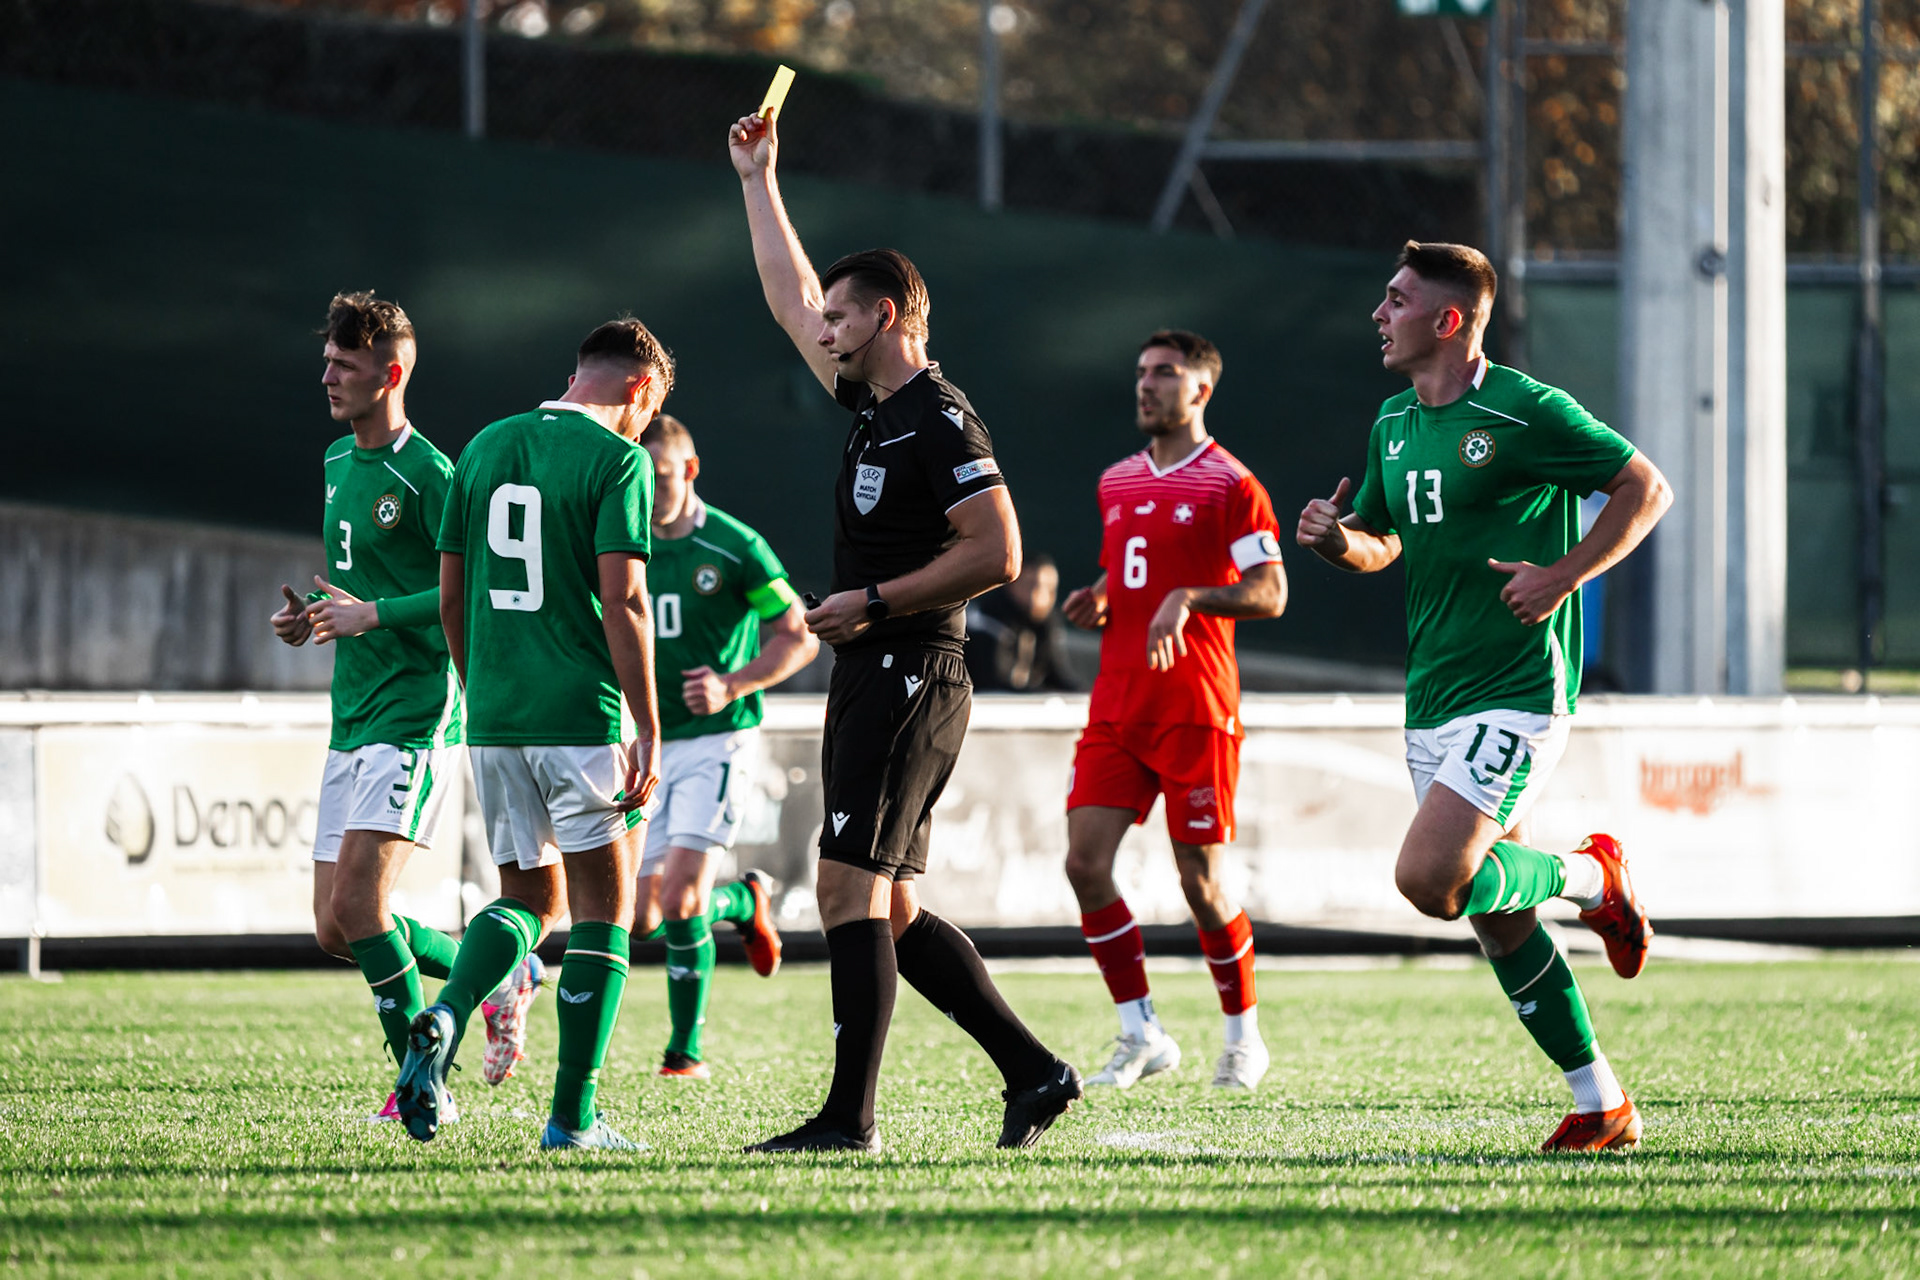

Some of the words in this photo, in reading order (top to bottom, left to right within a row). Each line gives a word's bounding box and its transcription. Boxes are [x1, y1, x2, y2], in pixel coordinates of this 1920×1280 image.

[856, 492, 877, 501] OFFICIAL
[860, 485, 877, 493] MATCH
[861, 469, 880, 482] UEFA
[1406, 469, 1443, 524] 13
[336, 519, 352, 571] 3
[487, 483, 544, 612] 9
[1124, 536, 1147, 589] 6
[648, 593, 681, 638] 0
[393, 747, 418, 792] 3
[1464, 723, 1520, 776] 13
